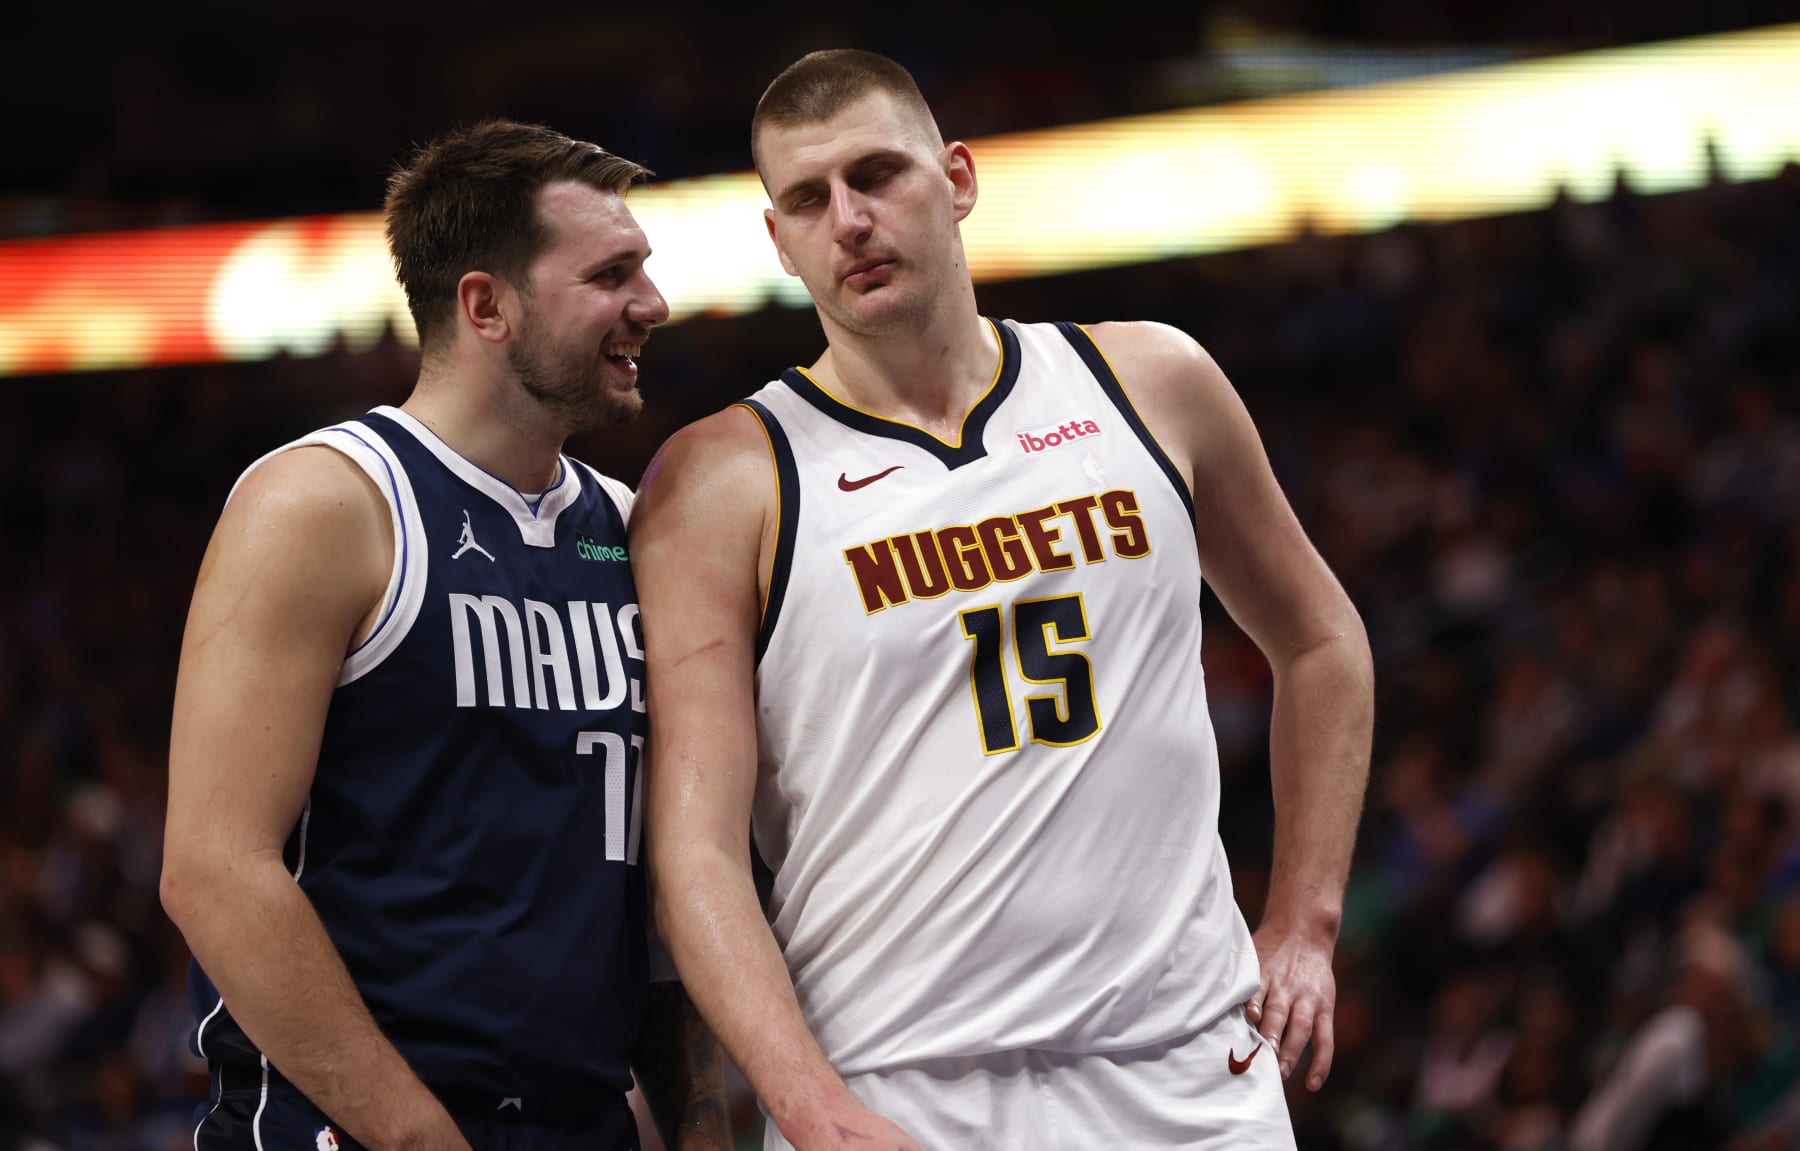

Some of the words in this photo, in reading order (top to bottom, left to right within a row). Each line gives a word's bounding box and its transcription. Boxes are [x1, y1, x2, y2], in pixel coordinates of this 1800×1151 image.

[1017, 420, 1100, 453] ibotta
[577, 536, 628, 561] chime
[842, 490, 1151, 615] NUGGETS
[958, 592, 1102, 756] 15
